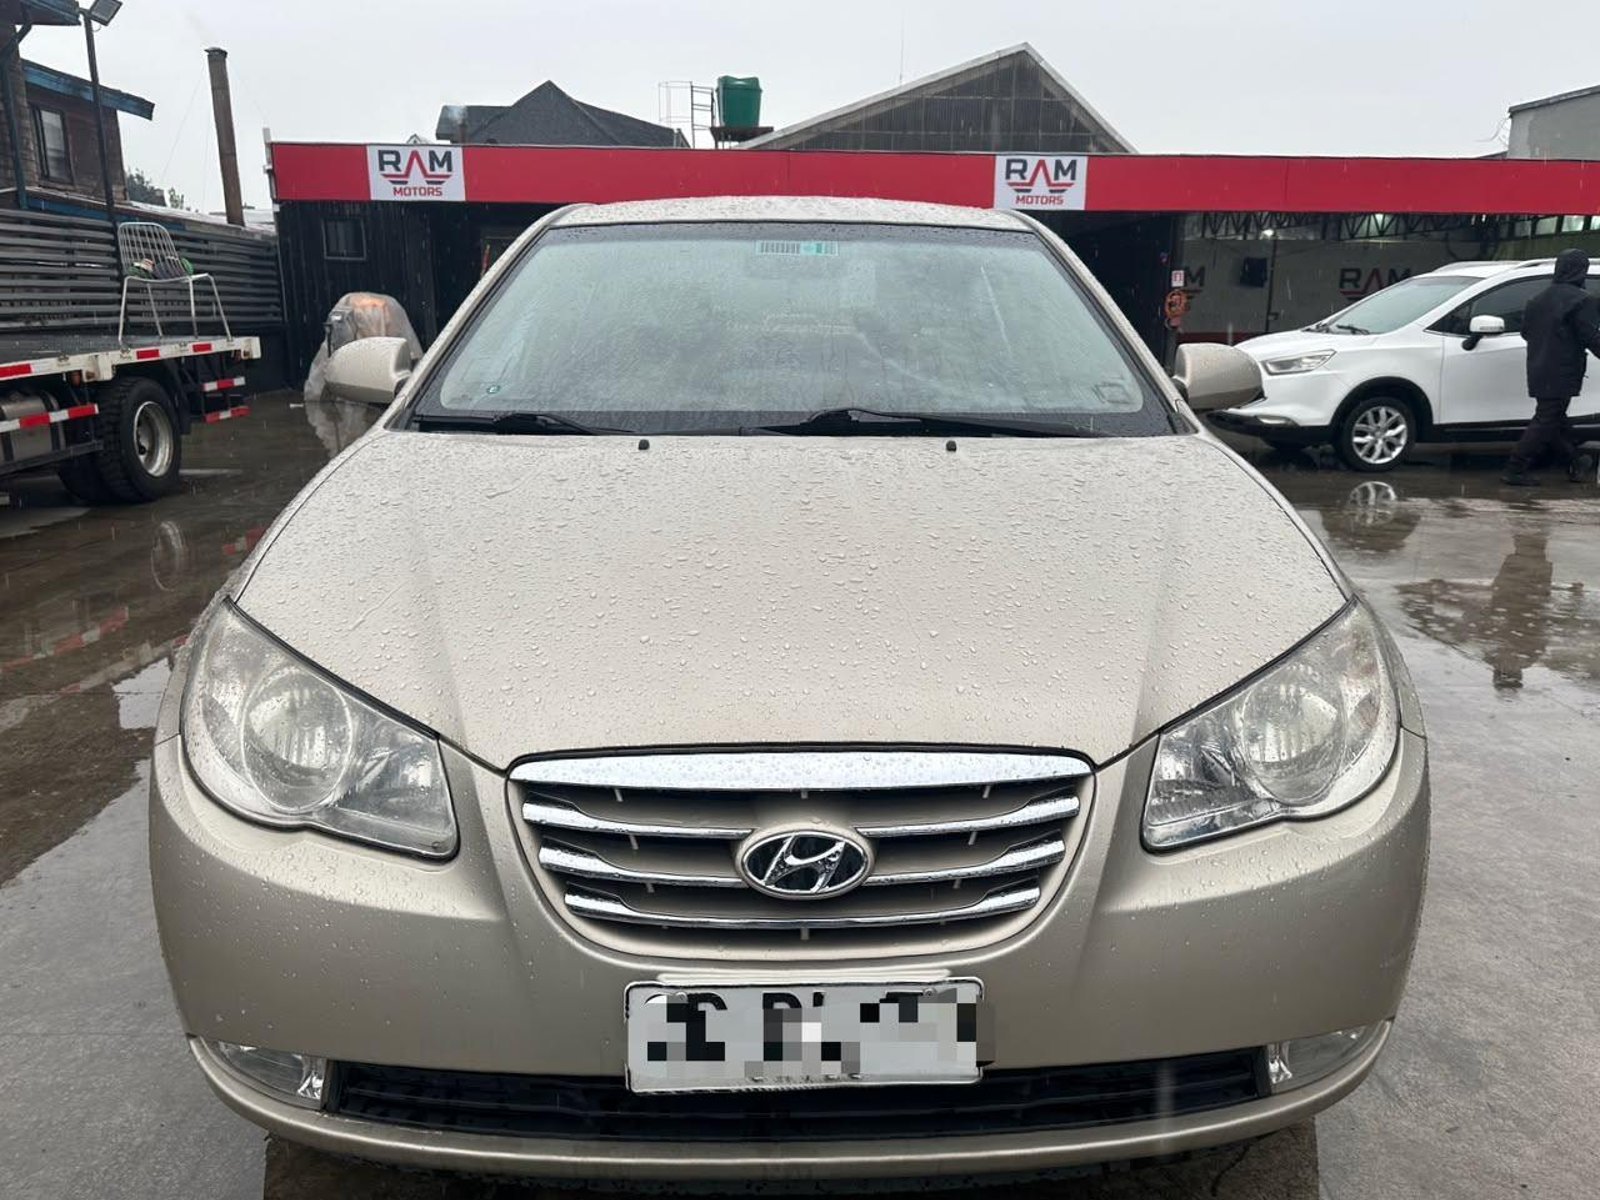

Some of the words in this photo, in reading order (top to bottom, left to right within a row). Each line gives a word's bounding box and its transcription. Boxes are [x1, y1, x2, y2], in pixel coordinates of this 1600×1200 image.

[378, 149, 453, 178] RAM
[1005, 158, 1078, 187] RAM
[393, 187, 443, 197] MOTORS
[1015, 195, 1065, 206] MOTORS
